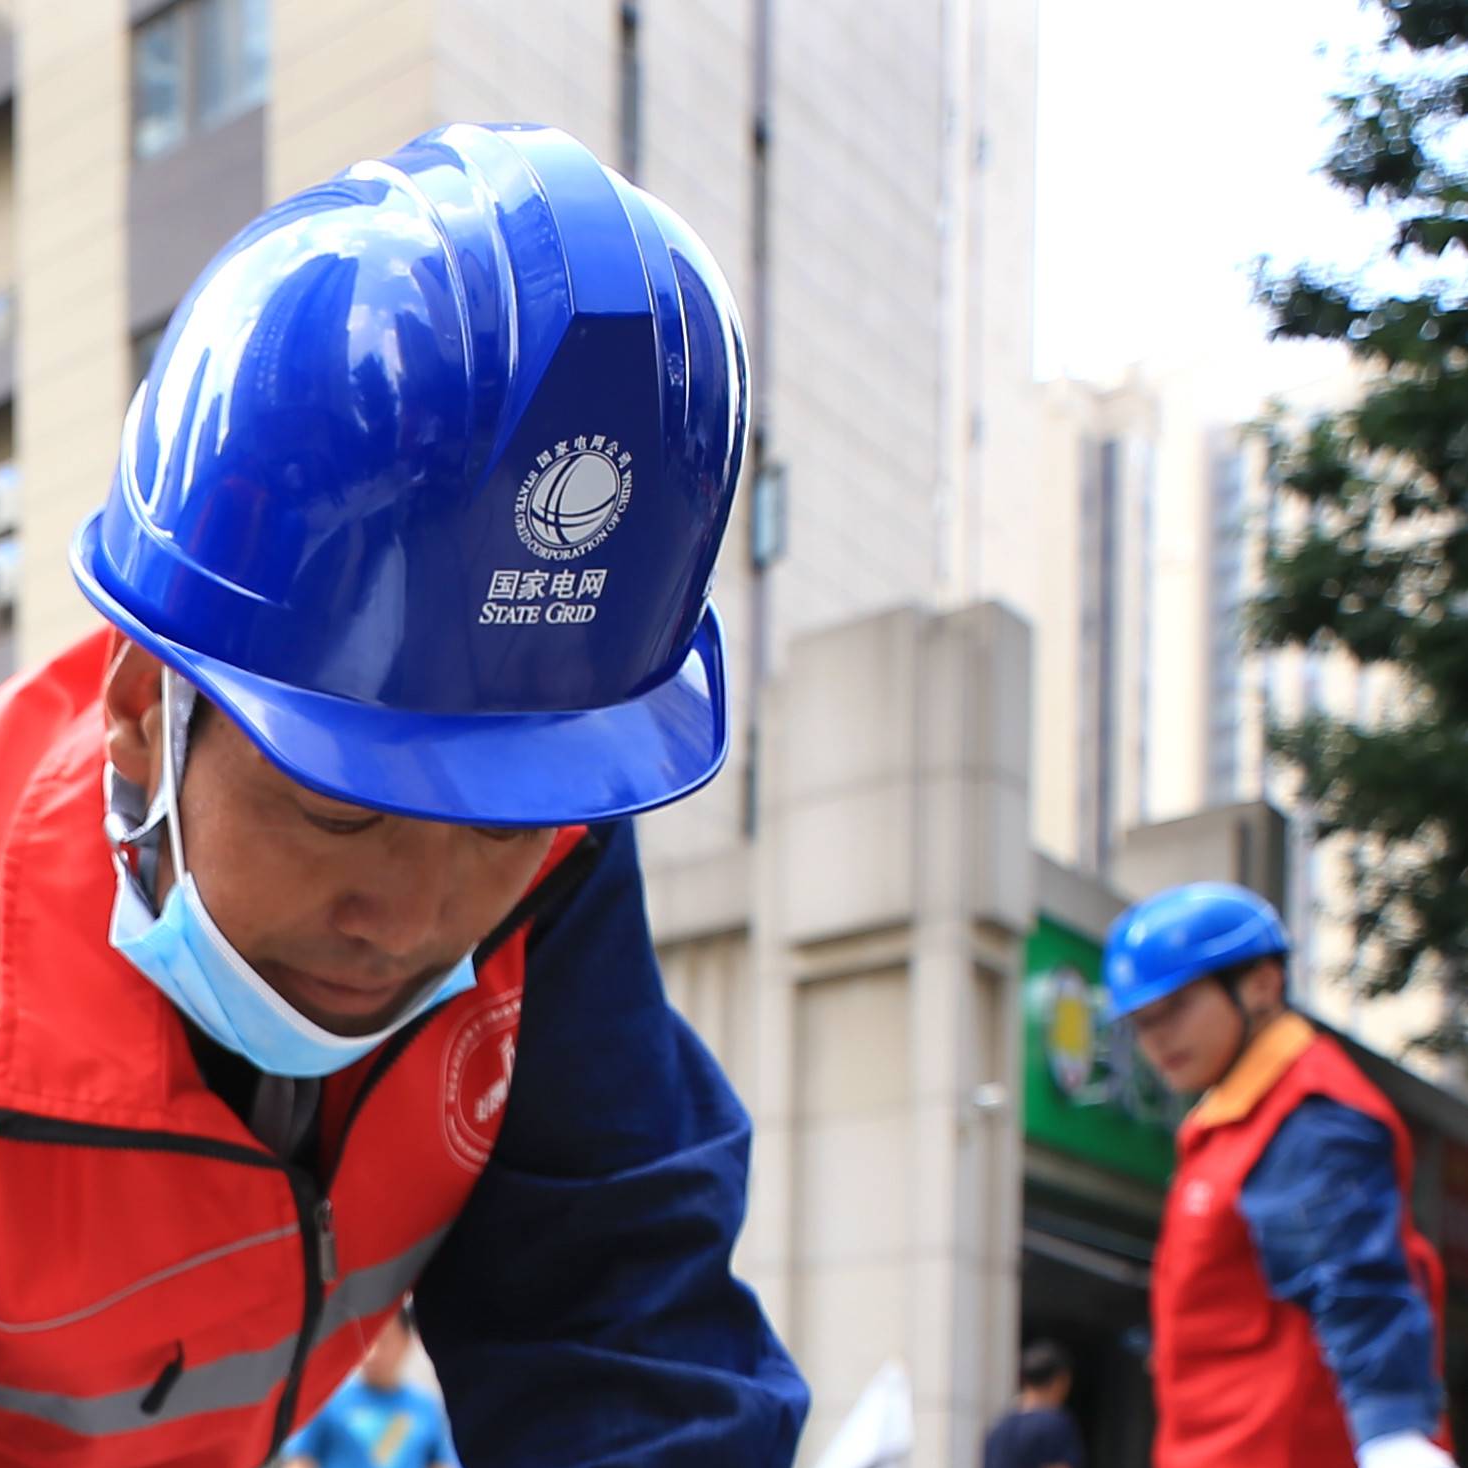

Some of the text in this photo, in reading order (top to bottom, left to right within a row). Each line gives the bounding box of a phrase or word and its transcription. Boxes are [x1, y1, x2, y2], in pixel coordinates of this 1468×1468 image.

[515, 470, 540, 513] STATE
[616, 469, 633, 514] CHINA
[527, 529, 609, 561] CORPORATION
[487, 568, 608, 601] 国家电网
